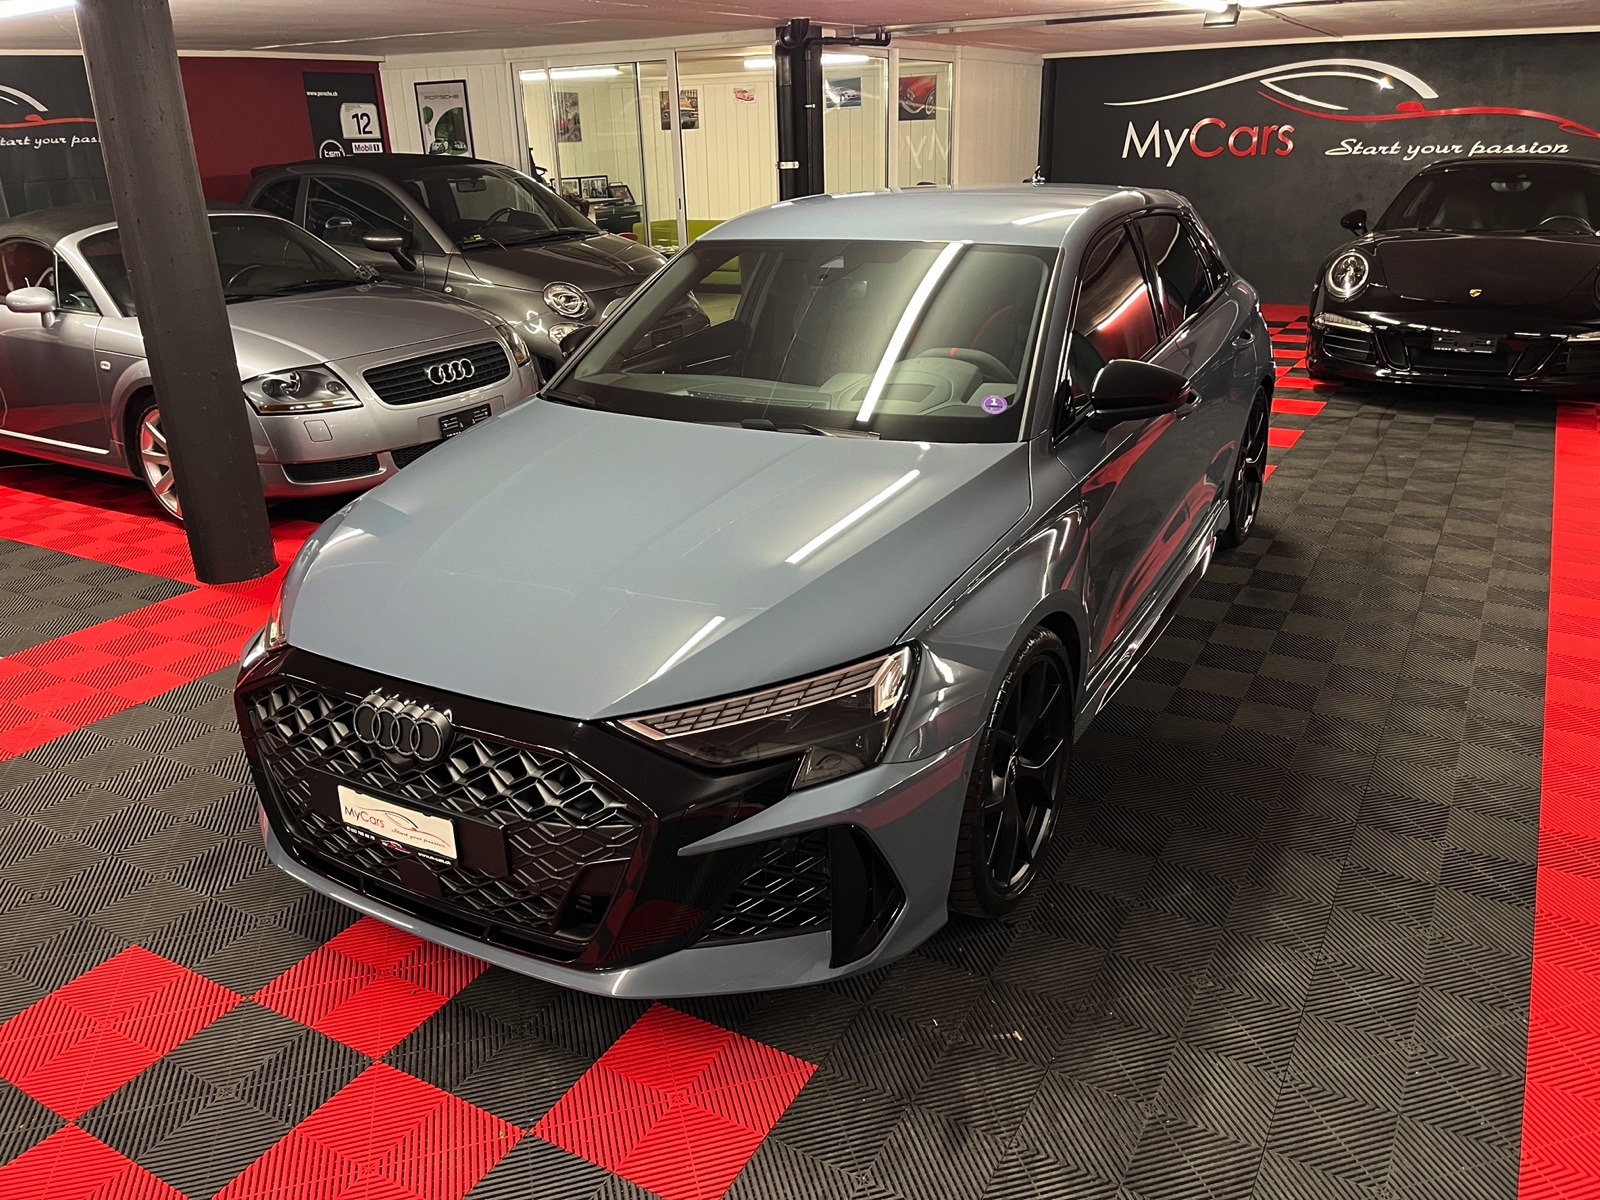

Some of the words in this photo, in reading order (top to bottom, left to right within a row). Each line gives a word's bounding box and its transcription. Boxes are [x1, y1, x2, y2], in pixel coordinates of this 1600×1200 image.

[351, 112, 373, 135] 12
[0, 136, 31, 146] tart
[34, 137, 67, 149] your
[354, 144, 373, 152] Mobil
[1122, 117, 1295, 167] MyCars
[1325, 138, 1401, 156] Start
[1403, 142, 1463, 161] your
[1468, 140, 1569, 157] passion
[324, 149, 342, 158] tsm
[345, 806, 384, 828] MyCars
